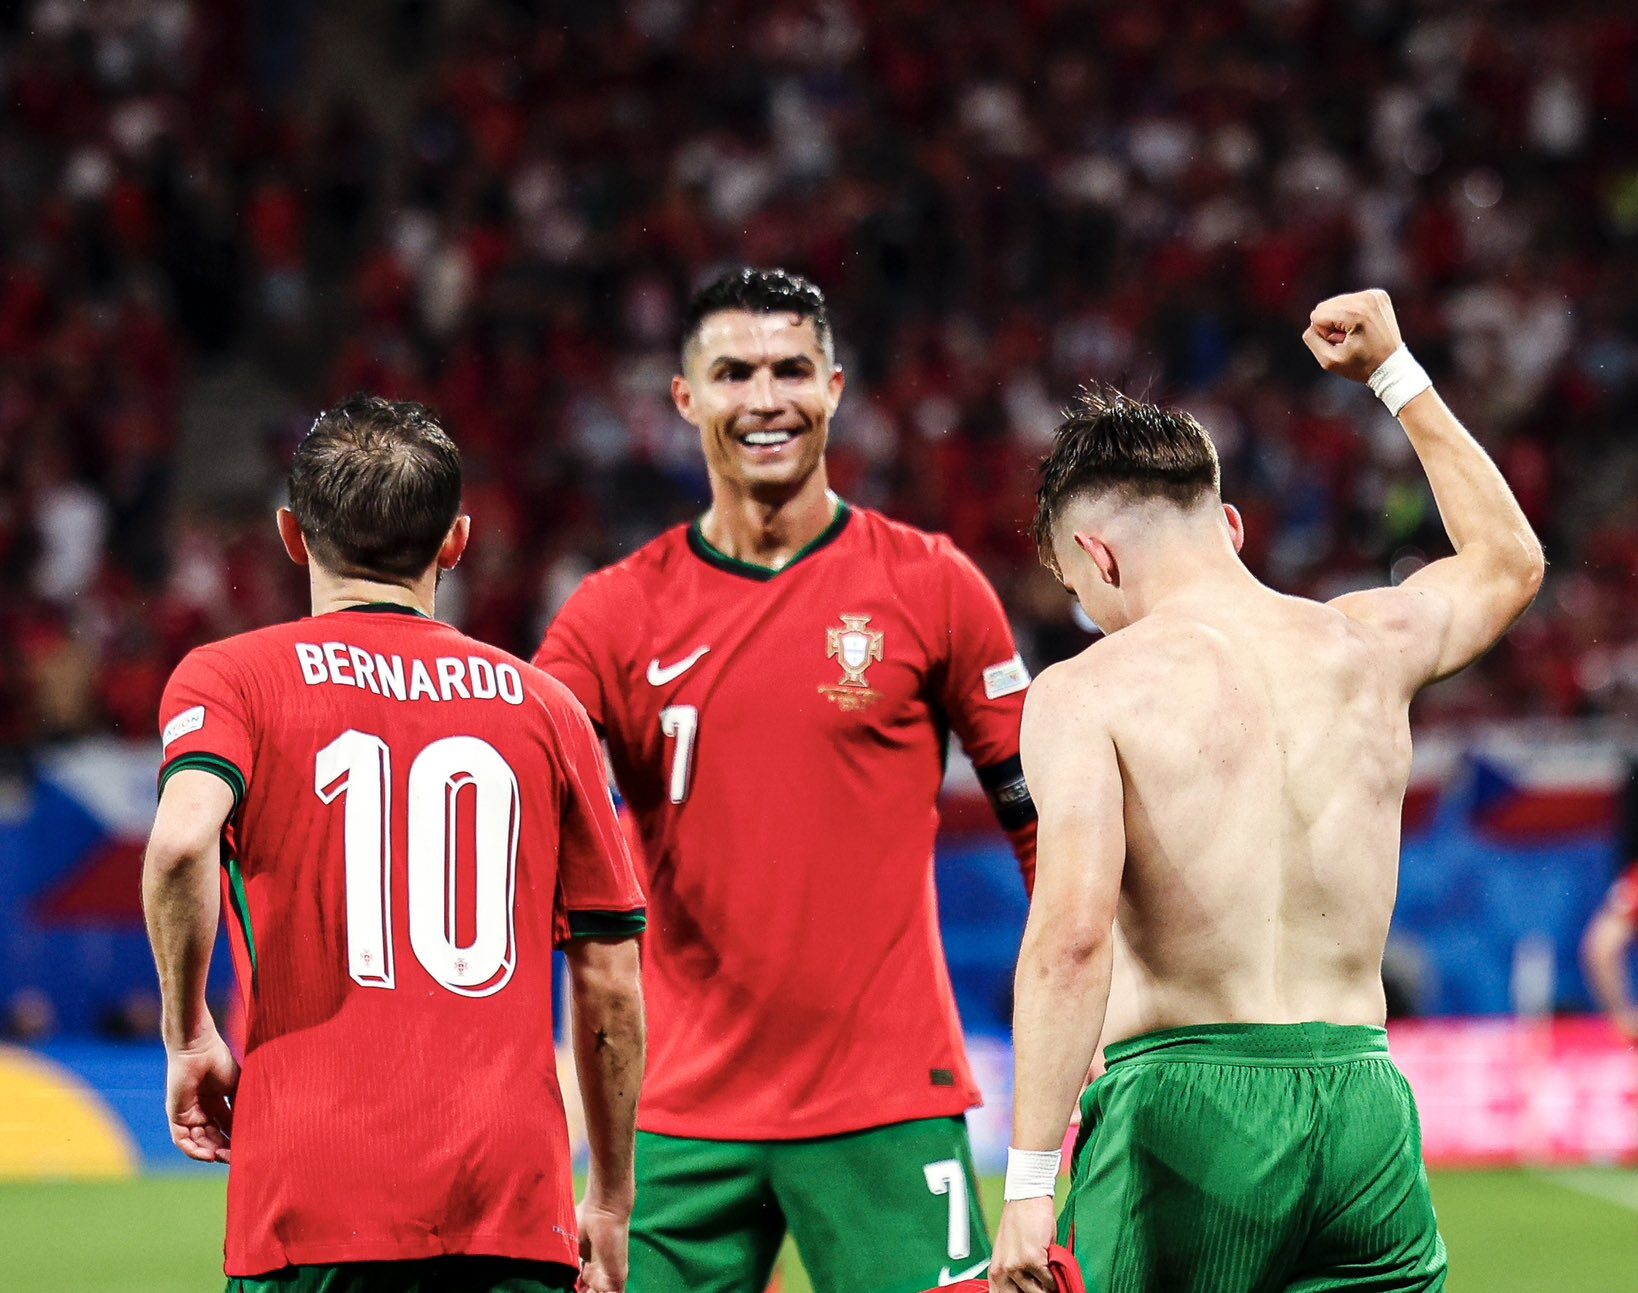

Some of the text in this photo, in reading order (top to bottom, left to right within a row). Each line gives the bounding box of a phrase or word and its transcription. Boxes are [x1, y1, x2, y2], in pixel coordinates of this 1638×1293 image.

[295, 642, 524, 705] BERNARDO
[659, 704, 698, 804] 7
[315, 728, 521, 998] 10
[923, 1159, 971, 1260] 7
